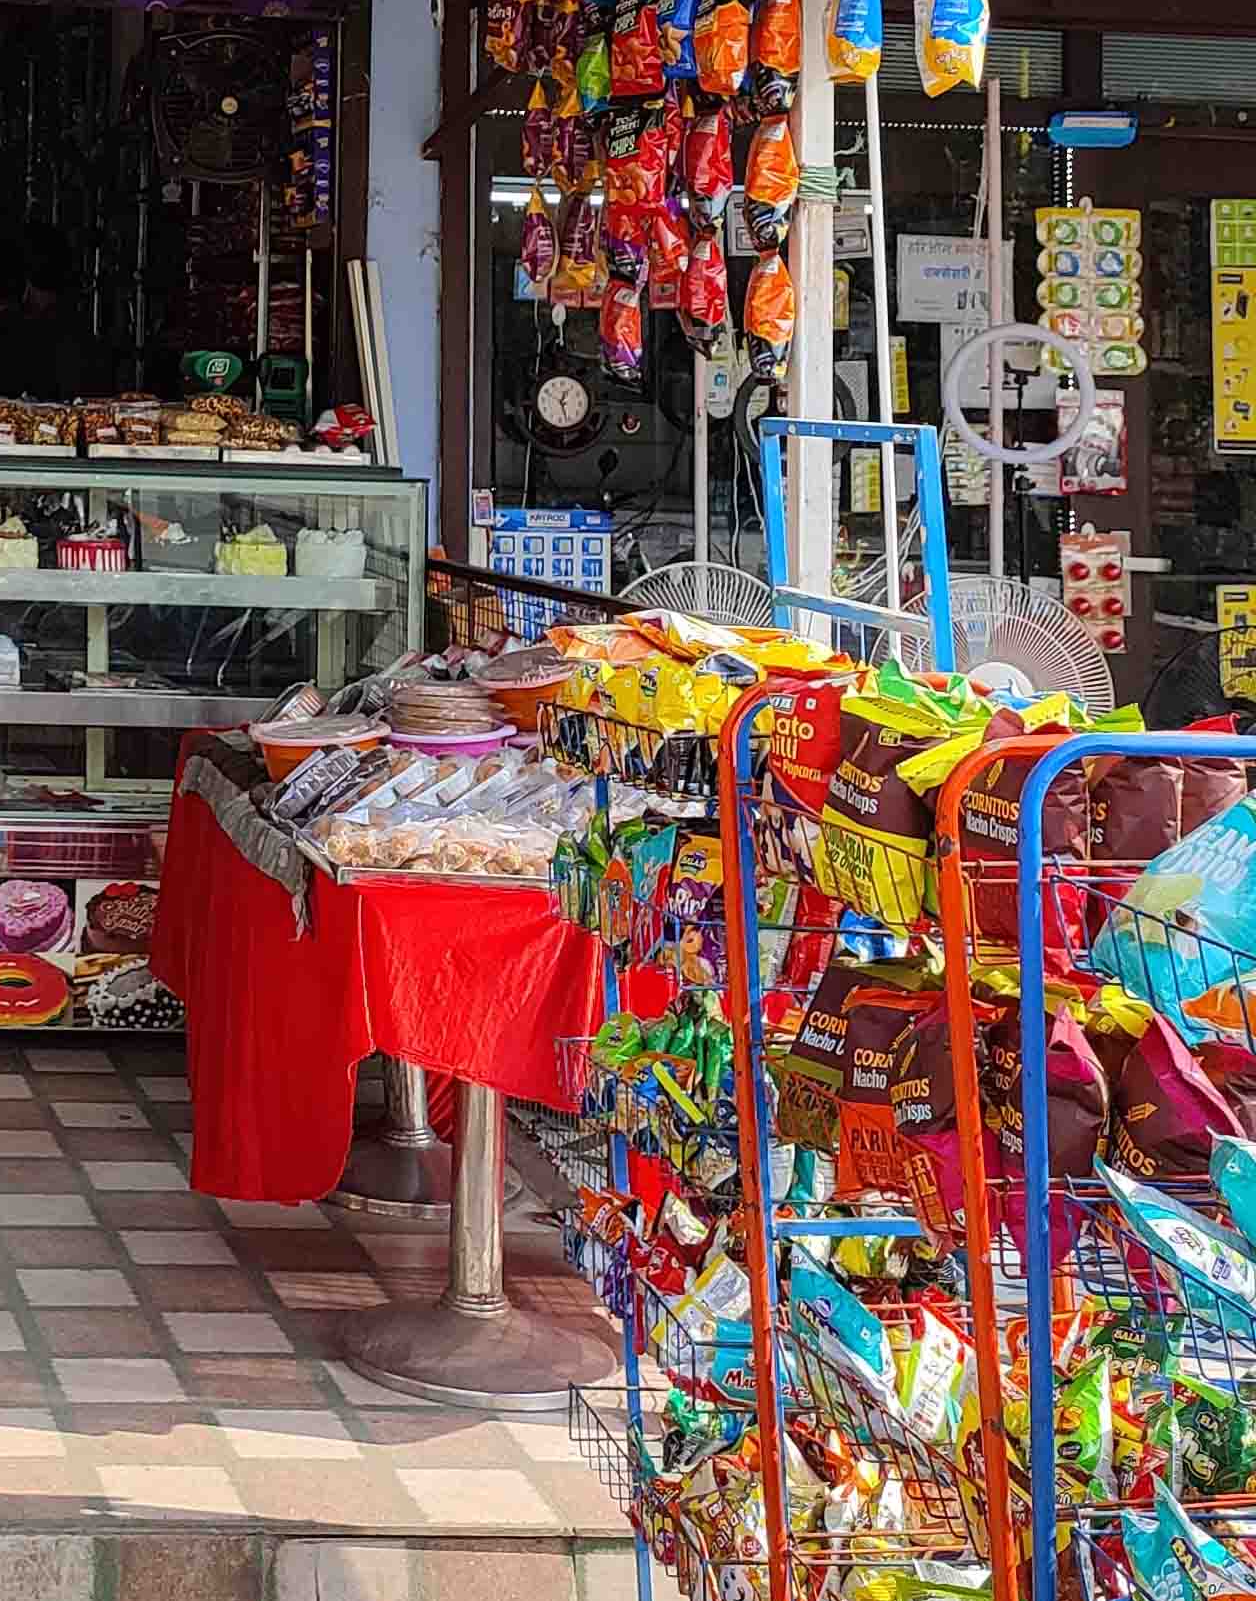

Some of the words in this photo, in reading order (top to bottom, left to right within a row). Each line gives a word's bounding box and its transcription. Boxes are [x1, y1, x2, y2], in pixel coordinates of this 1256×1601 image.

[967, 790, 1020, 821] CORNITOS
[989, 817, 1019, 847] Crisps
[800, 1023, 836, 1053] Nacho
[809, 1011, 848, 1036] CORN
[853, 1066, 887, 1090] Nacho
